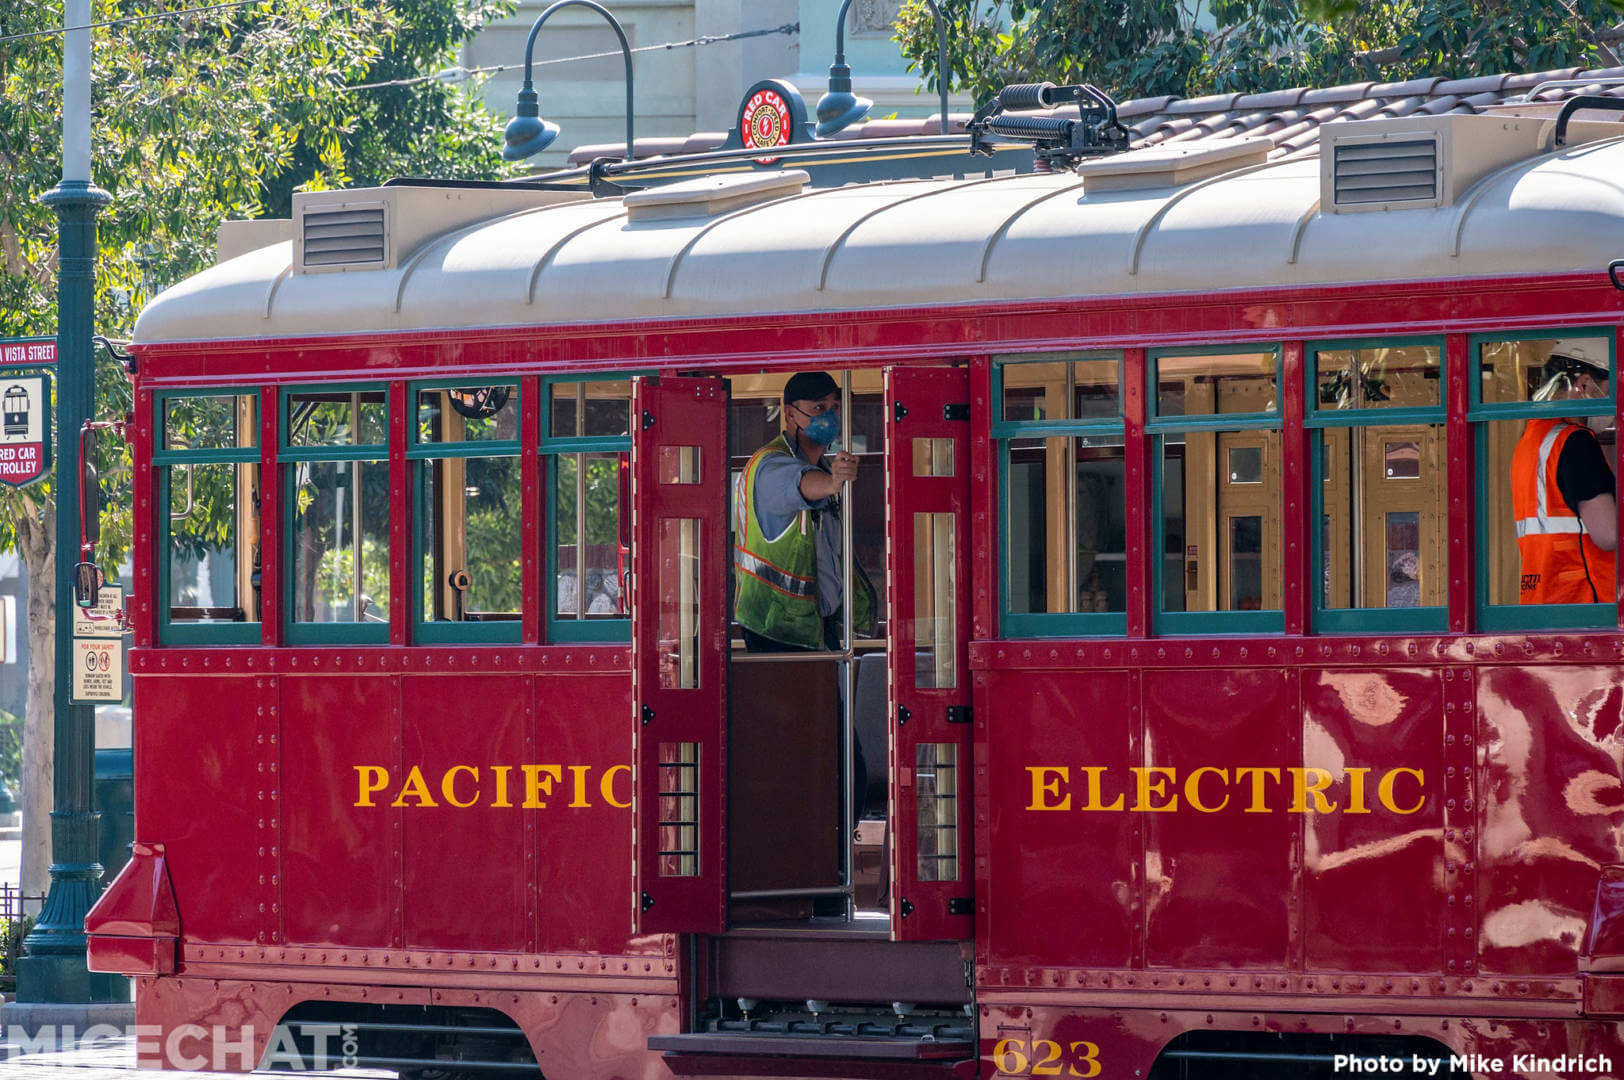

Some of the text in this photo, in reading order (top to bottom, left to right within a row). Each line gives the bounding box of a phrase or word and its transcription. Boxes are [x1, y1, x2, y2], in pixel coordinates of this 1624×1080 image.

[744, 91, 787, 121] RED CAR
[5, 346, 26, 362] VISTA
[28, 344, 55, 361] STREET
[0, 447, 36, 461] RED CAR
[0, 461, 37, 474] TROLLEY
[353, 764, 632, 808] PACIFIC
[1025, 766, 1426, 815] ELECTRIC
[993, 1038, 1102, 1078] 623
